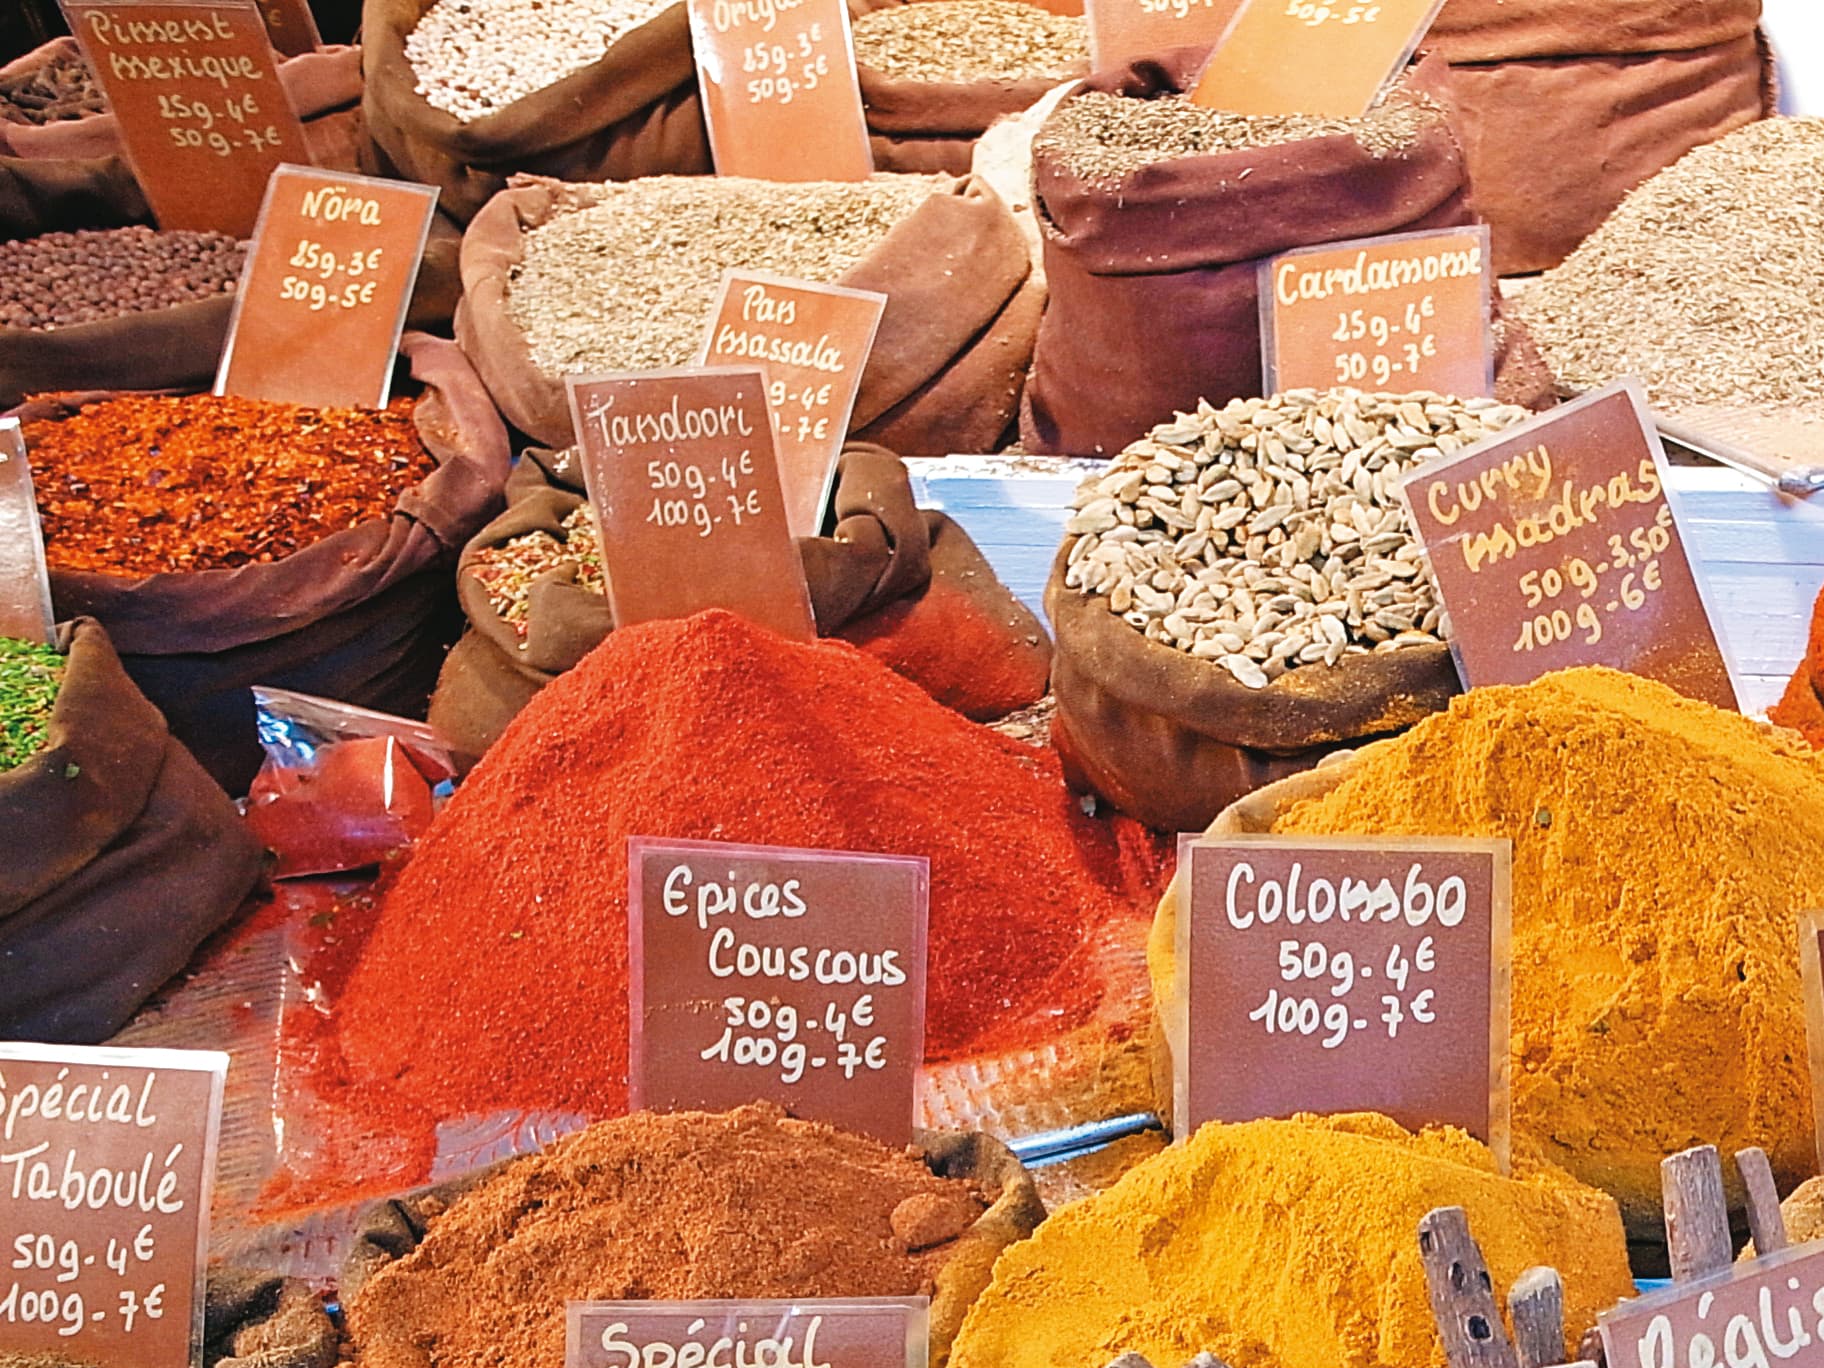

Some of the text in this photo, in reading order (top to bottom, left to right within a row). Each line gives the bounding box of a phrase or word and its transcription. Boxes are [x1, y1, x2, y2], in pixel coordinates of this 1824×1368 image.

[84, 10, 235, 45] Piment
[1276, 247, 1482, 306] Cardamome
[586, 391, 753, 447] Tandoori
[1427, 444, 1552, 525] Curry
[662, 863, 807, 930] Epices
[1225, 861, 1467, 930] Colombo
[707, 926, 908, 987] Couscous
[0, 1141, 184, 1214] Taboulé
